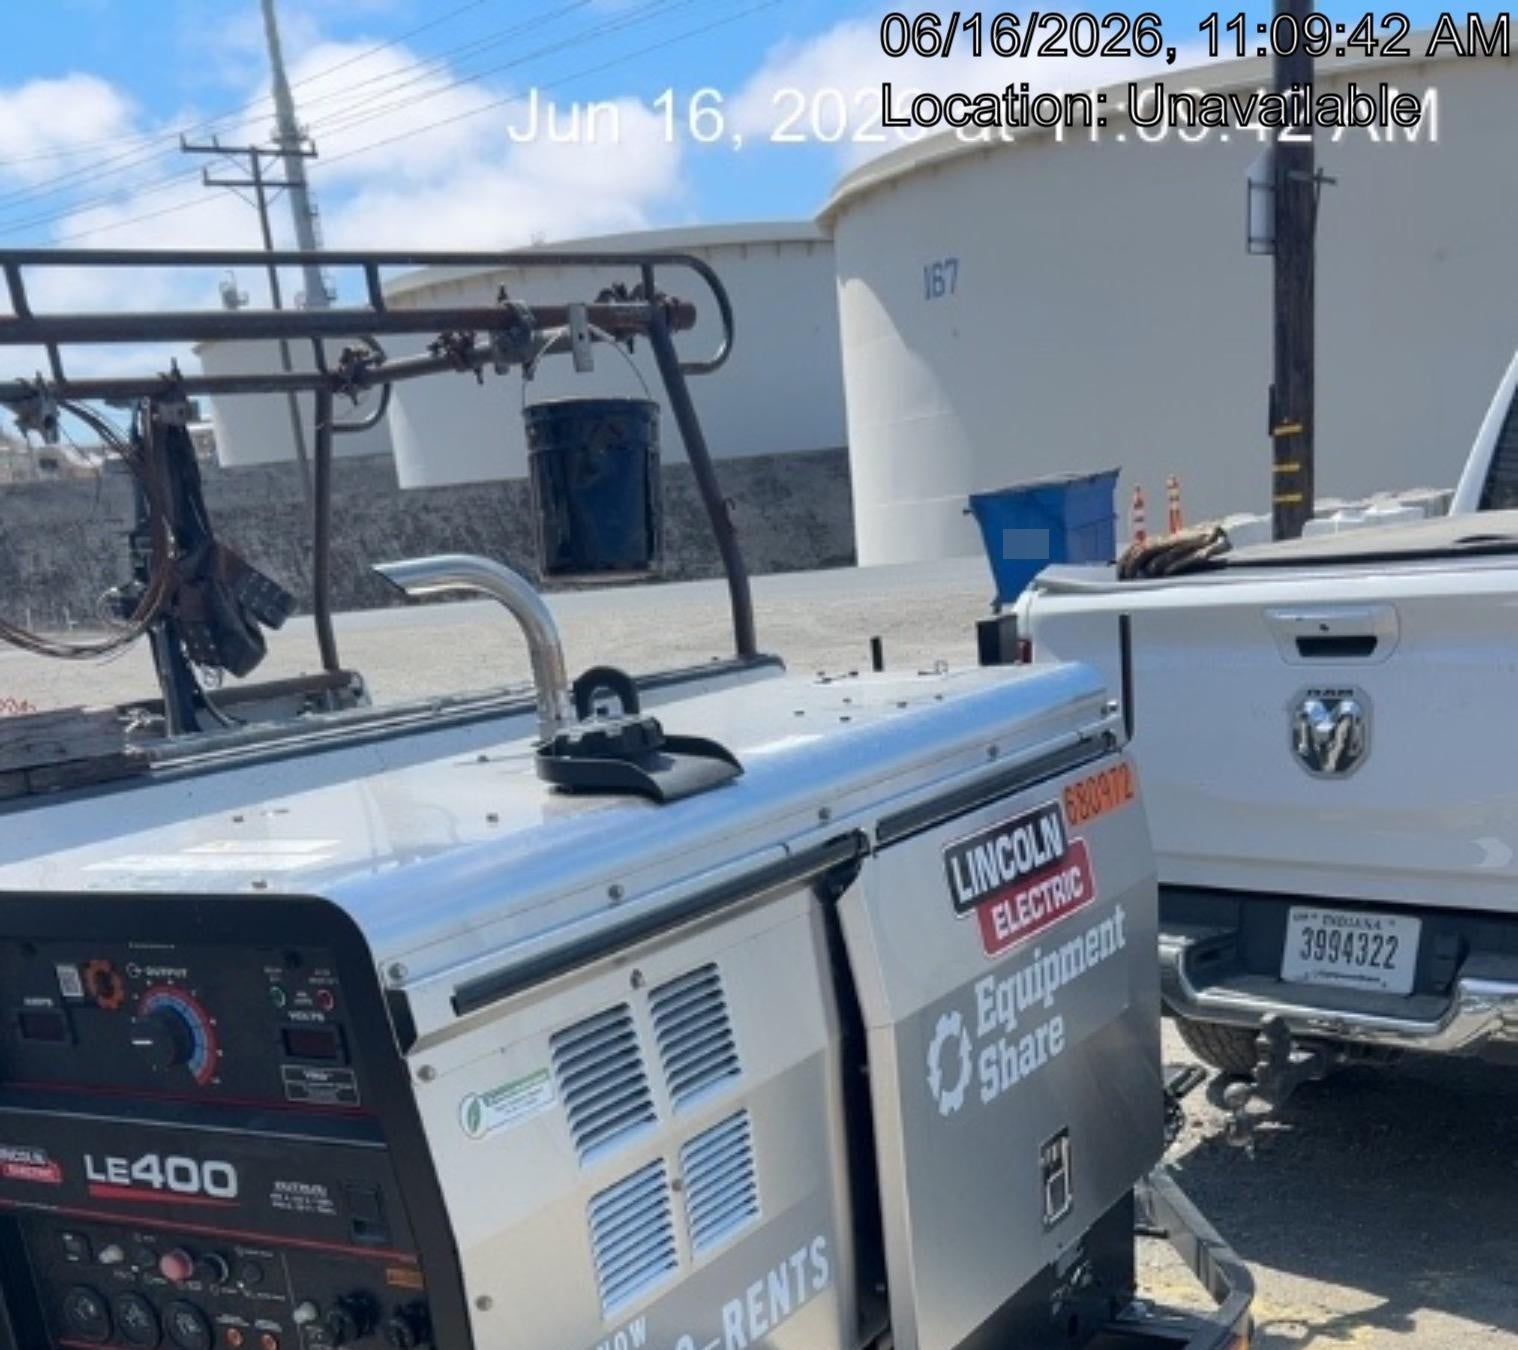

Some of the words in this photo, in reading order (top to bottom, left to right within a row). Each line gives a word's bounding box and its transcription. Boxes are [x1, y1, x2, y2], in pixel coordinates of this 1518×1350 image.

[923, 258, 958, 301] 167
[950, 812, 1064, 903] LINCOLN
[991, 866, 1084, 939] ELECTRIC
[975, 905, 1126, 1038] Equipment
[1300, 926, 1399, 970] 3994322
[979, 1015, 1065, 1105] Share
[84, 1155, 239, 1198] LE400
